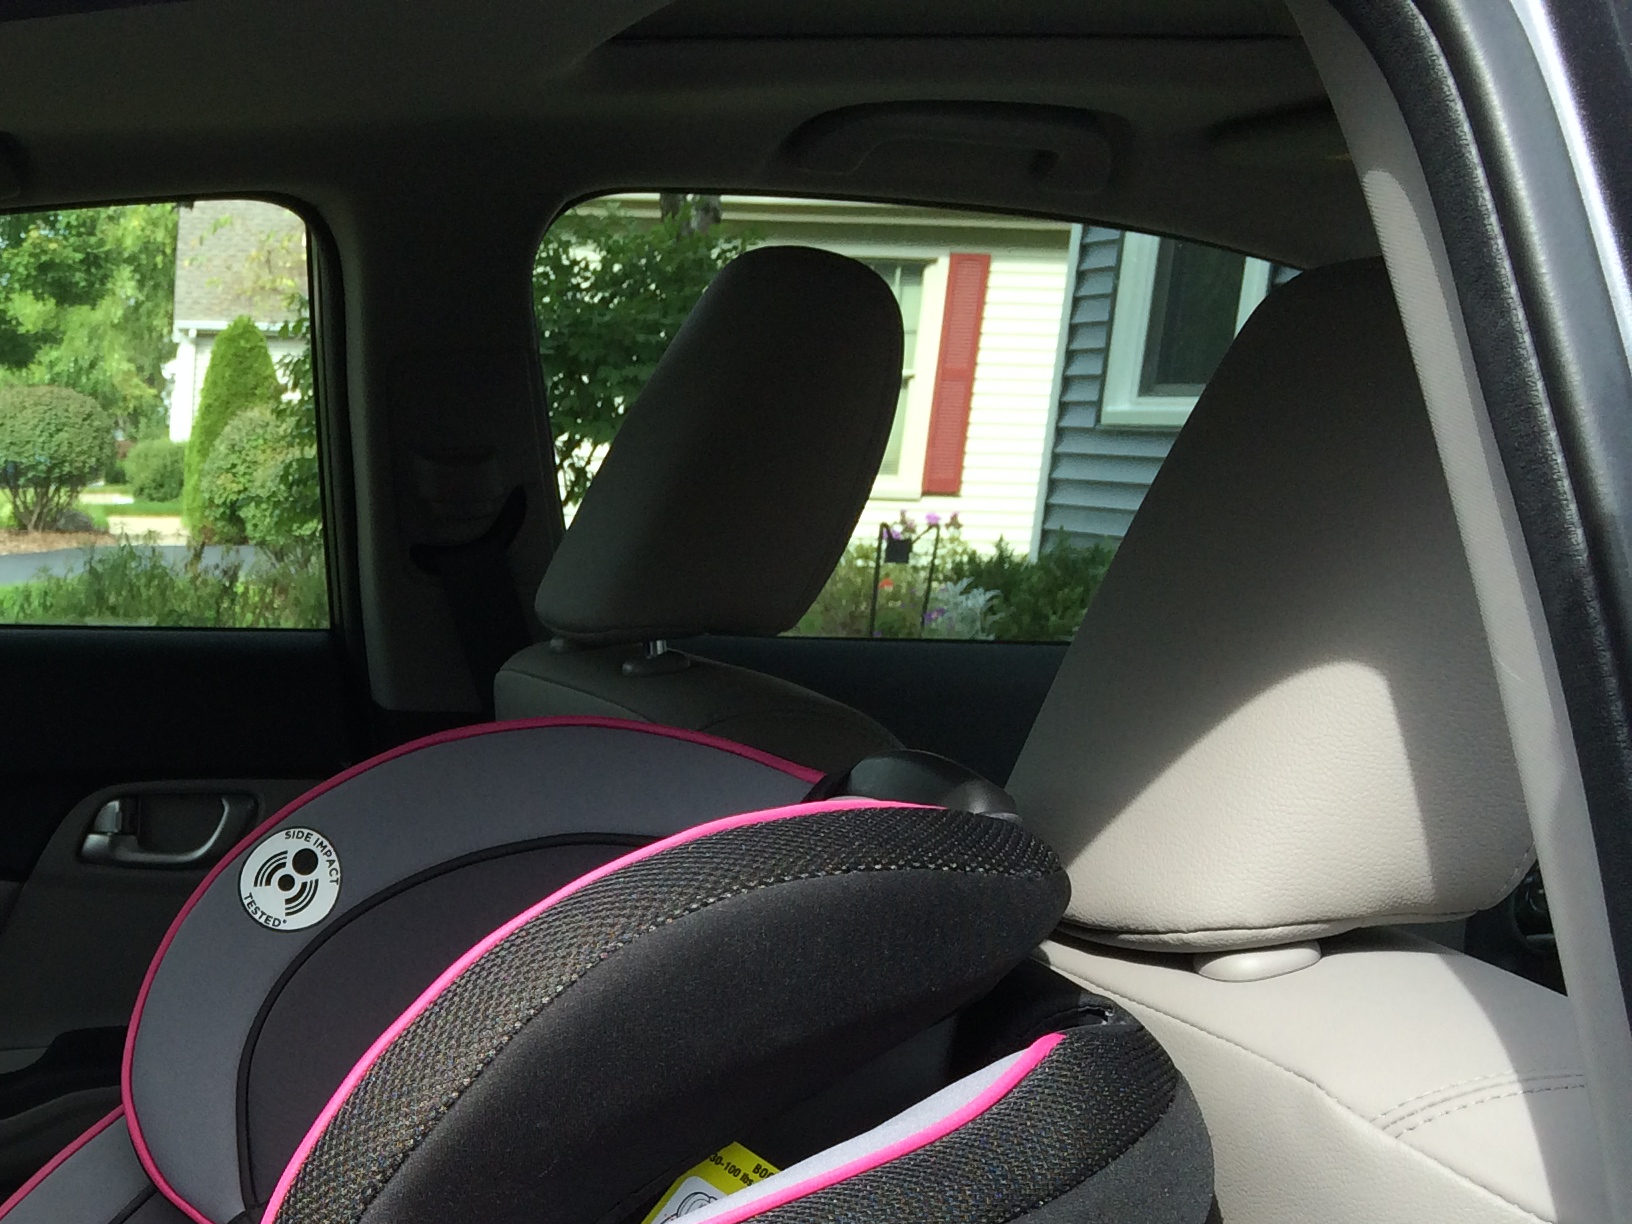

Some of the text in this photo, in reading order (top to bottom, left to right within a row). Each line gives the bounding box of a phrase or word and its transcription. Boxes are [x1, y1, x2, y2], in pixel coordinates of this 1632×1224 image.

[284, 830, 339, 885] SIDE IMPACT
[709, 1153, 754, 1186] 30-100 lbs
